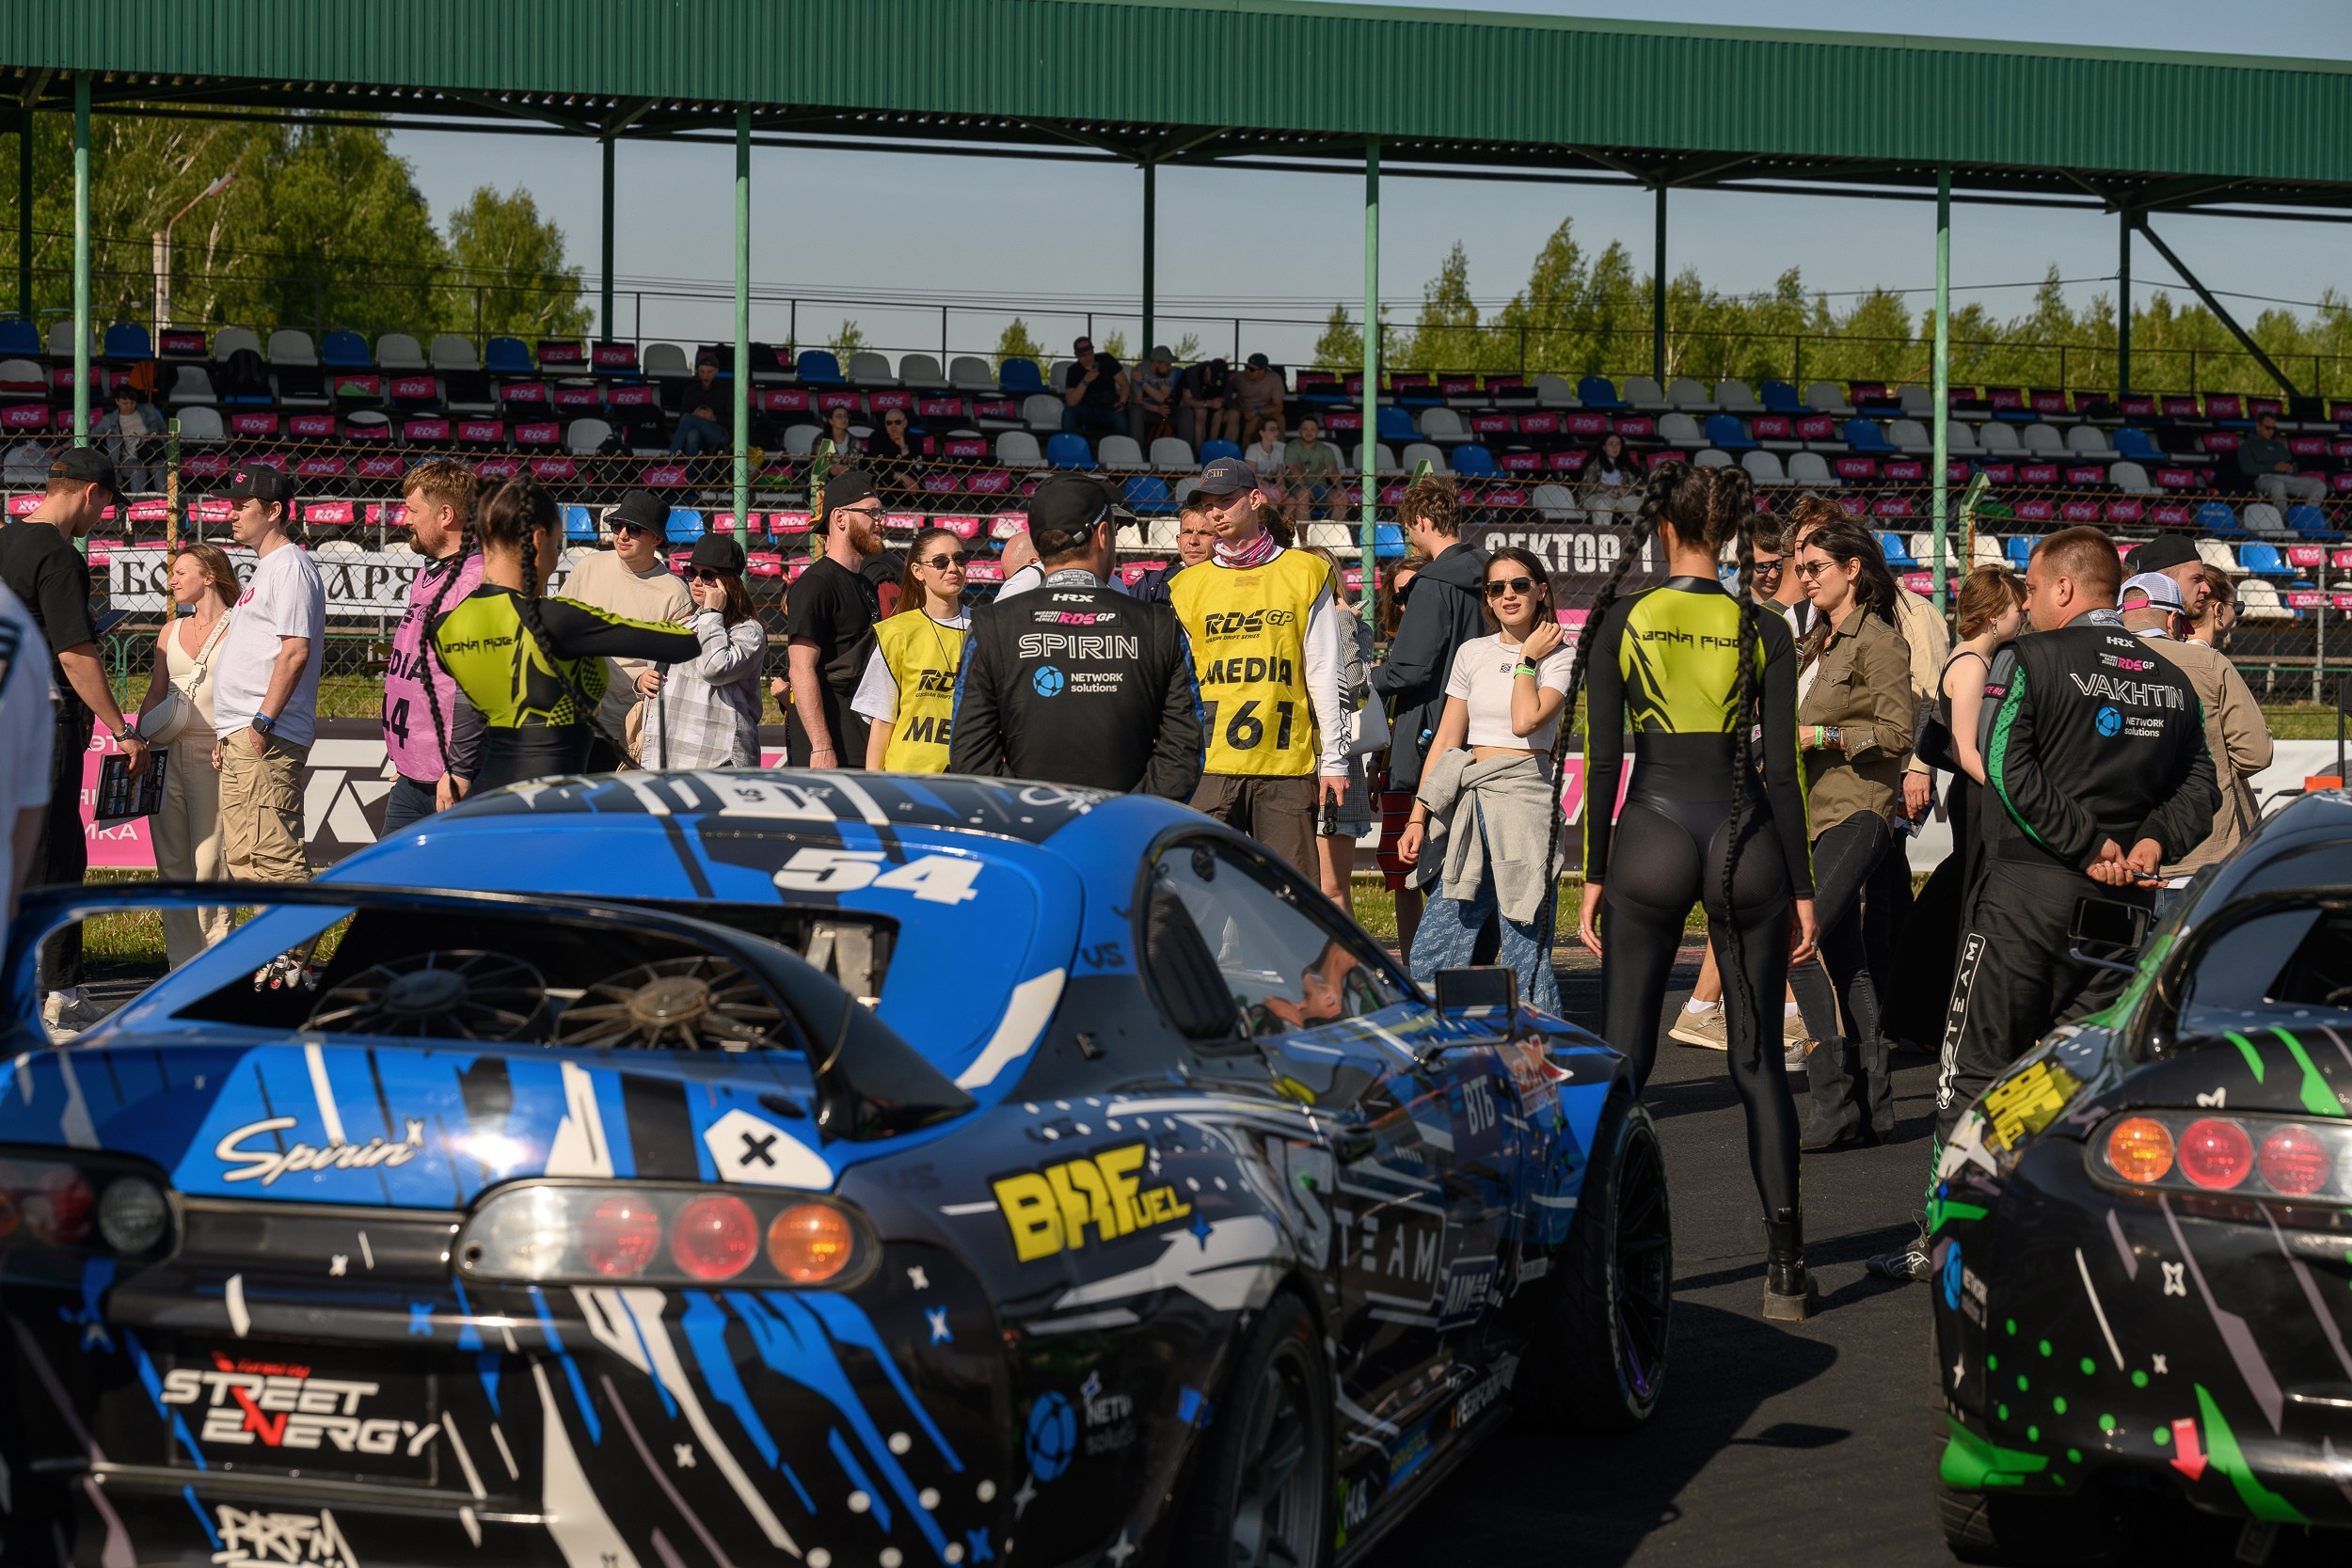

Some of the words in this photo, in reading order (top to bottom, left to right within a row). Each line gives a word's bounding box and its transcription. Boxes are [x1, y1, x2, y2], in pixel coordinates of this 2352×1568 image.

[601, 352, 628, 361] RDS
[400, 383, 426, 392] RDS
[510, 389, 536, 399] RDS
[564, 394, 589, 404] RDS
[617, 393, 644, 403] RDS
[773, 394, 800, 404] RDS
[878, 397, 903, 406] RDS
[11, 410, 40, 421] RDS
[241, 419, 269, 430] RDS
[298, 420, 326, 431] RDS
[1526, 419, 1551, 429] RDS
[1574, 419, 1597, 429] RDS
[1621, 422, 1645, 433] RDS
[1758, 421, 1782, 431] RDS
[1803, 421, 1826, 432] RDS
[414, 426, 440, 436] RDS
[468, 426, 494, 436] RDS
[525, 429, 551, 439] RDS
[953, 446, 979, 455] RDS
[1510, 458, 1534, 468] RDS
[1557, 456, 1582, 467] RDS
[1845, 463, 1867, 472] RDS
[1892, 468, 1915, 477] RDS
[2027, 470, 2050, 480] RDS
[1052, 593, 1095, 603] HRX
[1057, 611, 1098, 626] RDS
[1204, 609, 1267, 637] RDS
[1223, 633, 1240, 641] DRIFT
[2106, 636, 2135, 648] HRX
[1018, 633, 1138, 659] SPIRIN
[2117, 657, 2143, 672] RDS
[1200, 657, 1293, 687] MEDIA
[1071, 673, 1123, 682] NETWORK
[1071, 683, 1118, 692] solutions
[2070, 673, 2185, 711] VAKHTIN
[2125, 717, 2164, 728] NETWORK
[2124, 728, 2159, 737] solutions
[772, 847, 984, 906] 54
[215, 1117, 415, 1186] Spirin
[160, 1368, 379, 1416] STREET
[200, 1407, 440, 1457] ENERGY
